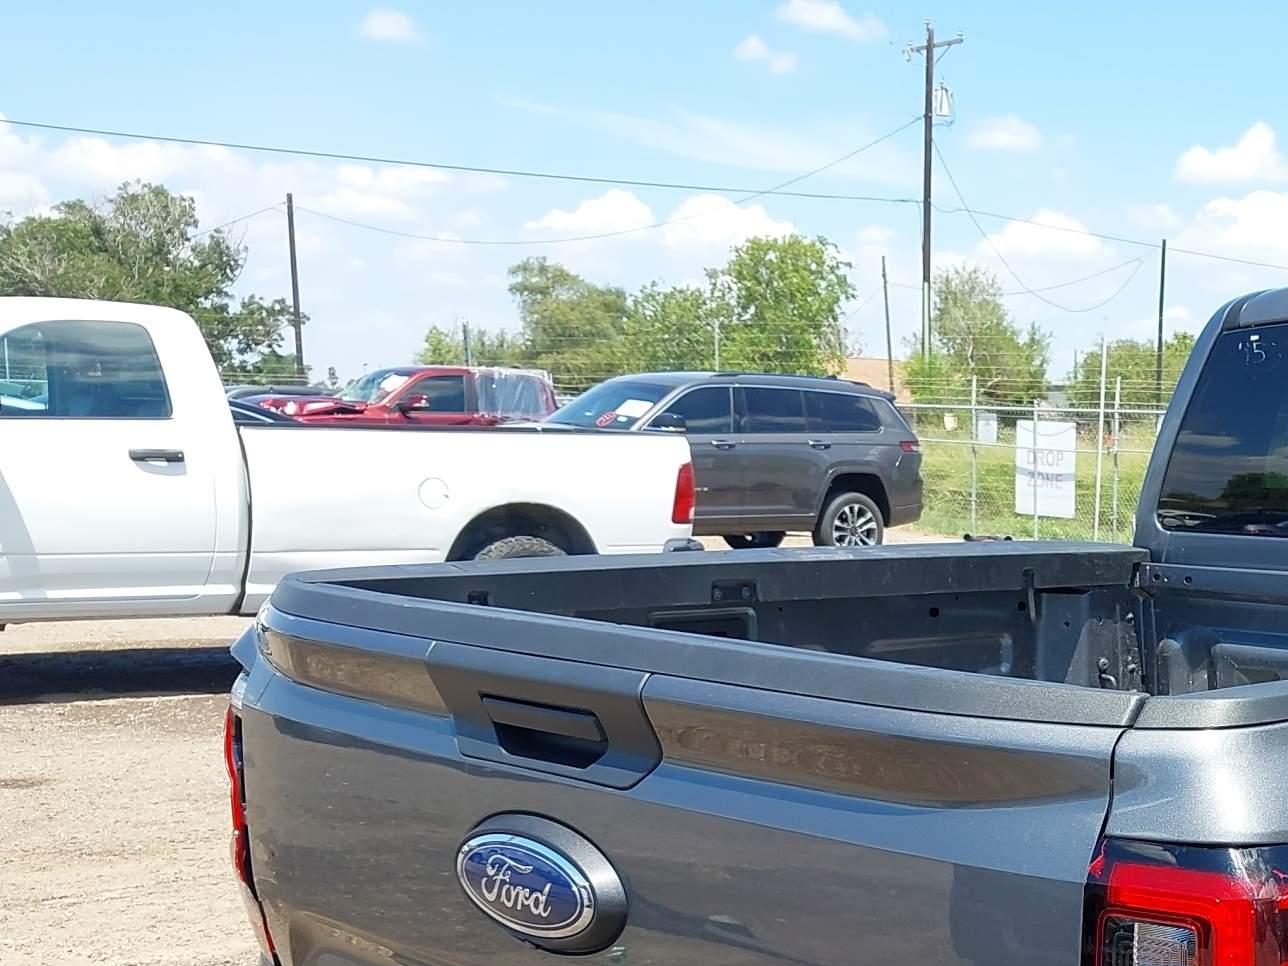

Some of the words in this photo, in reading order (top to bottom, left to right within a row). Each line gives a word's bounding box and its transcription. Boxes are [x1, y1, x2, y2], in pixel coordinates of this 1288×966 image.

[1026, 449, 1065, 467] DROP
[1026, 471, 1064, 489] ZONE
[481, 854, 553, 918] Ford
